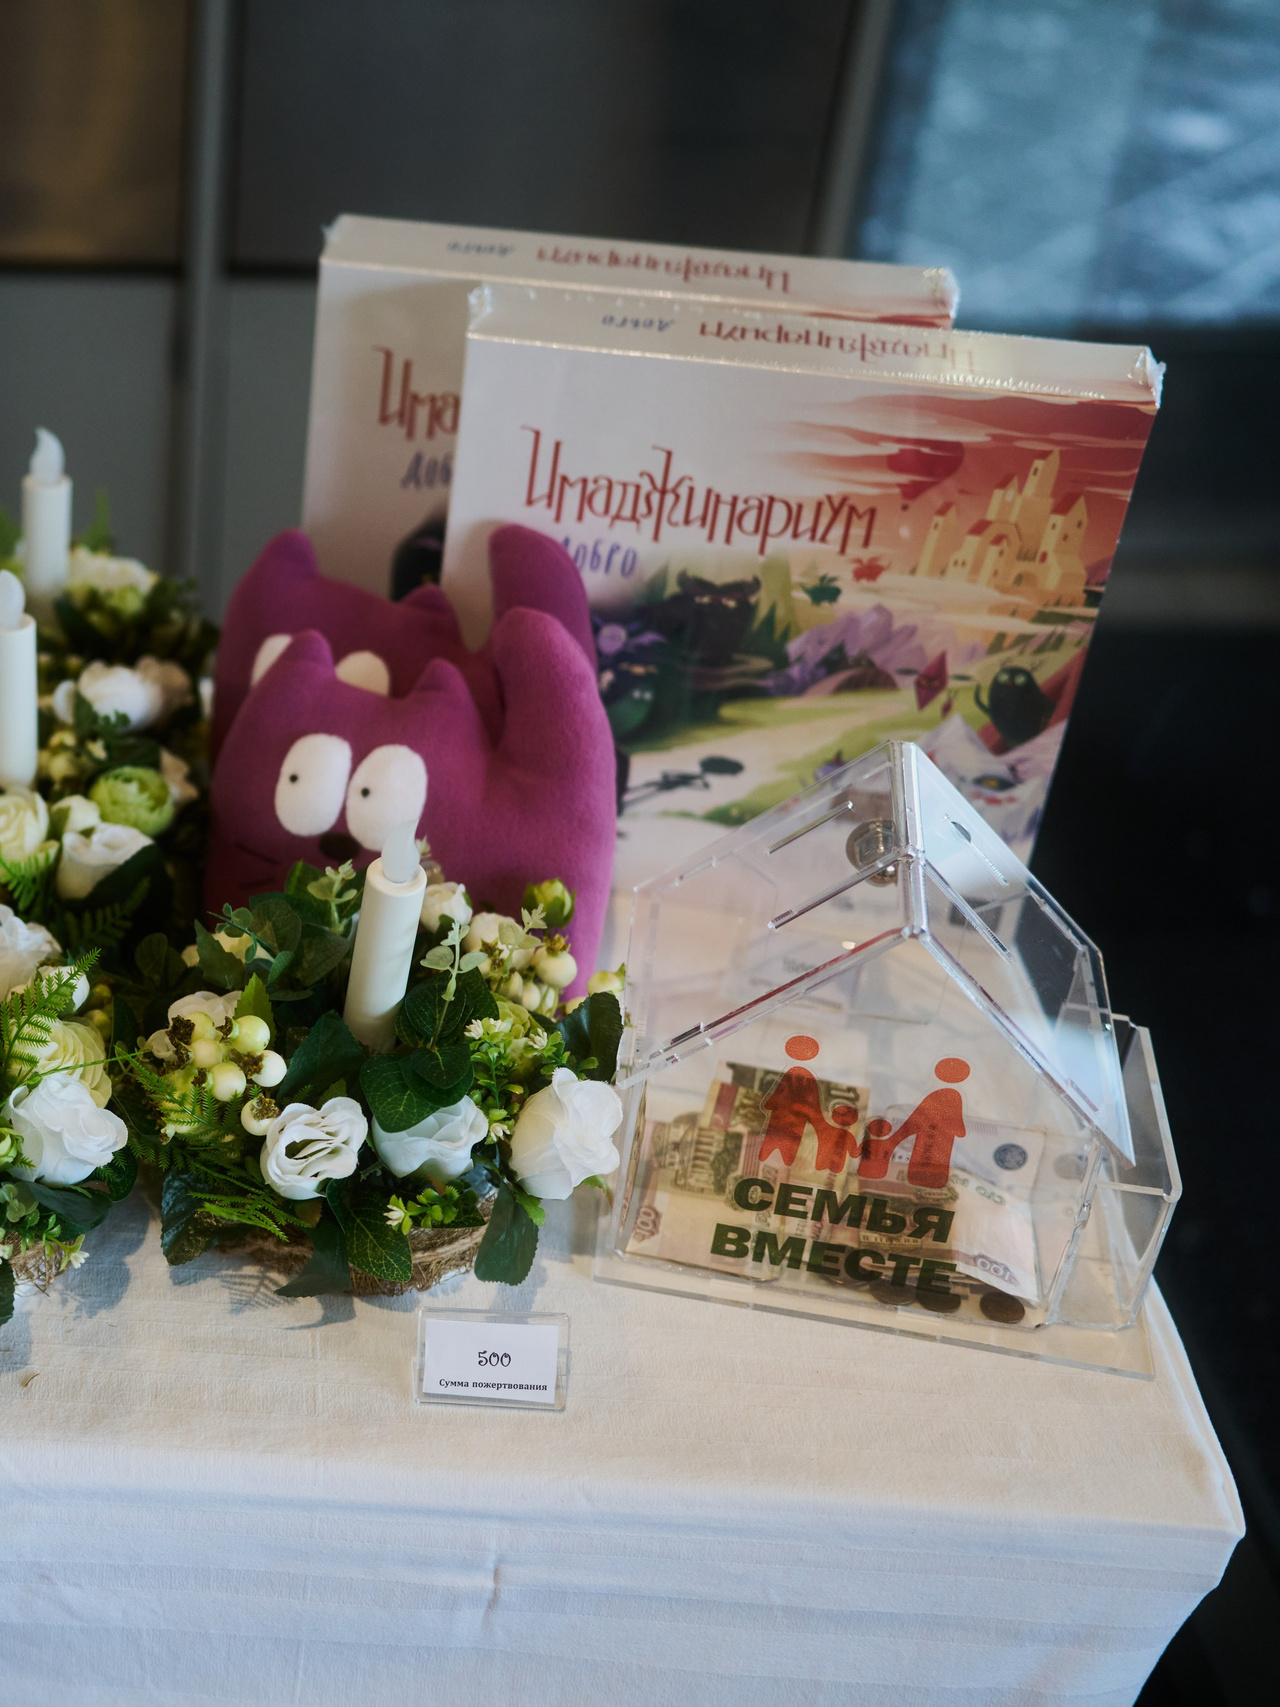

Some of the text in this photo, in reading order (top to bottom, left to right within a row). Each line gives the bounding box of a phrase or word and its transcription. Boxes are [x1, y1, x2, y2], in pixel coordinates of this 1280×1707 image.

[562, 536, 638, 578] обро
[732, 1177, 956, 1244] СЕМЬЯ
[709, 1222, 958, 1295] ВМЕСТЕ
[477, 1350, 512, 1368] 500
[439, 1378, 548, 1391] Сумма пожертвования
